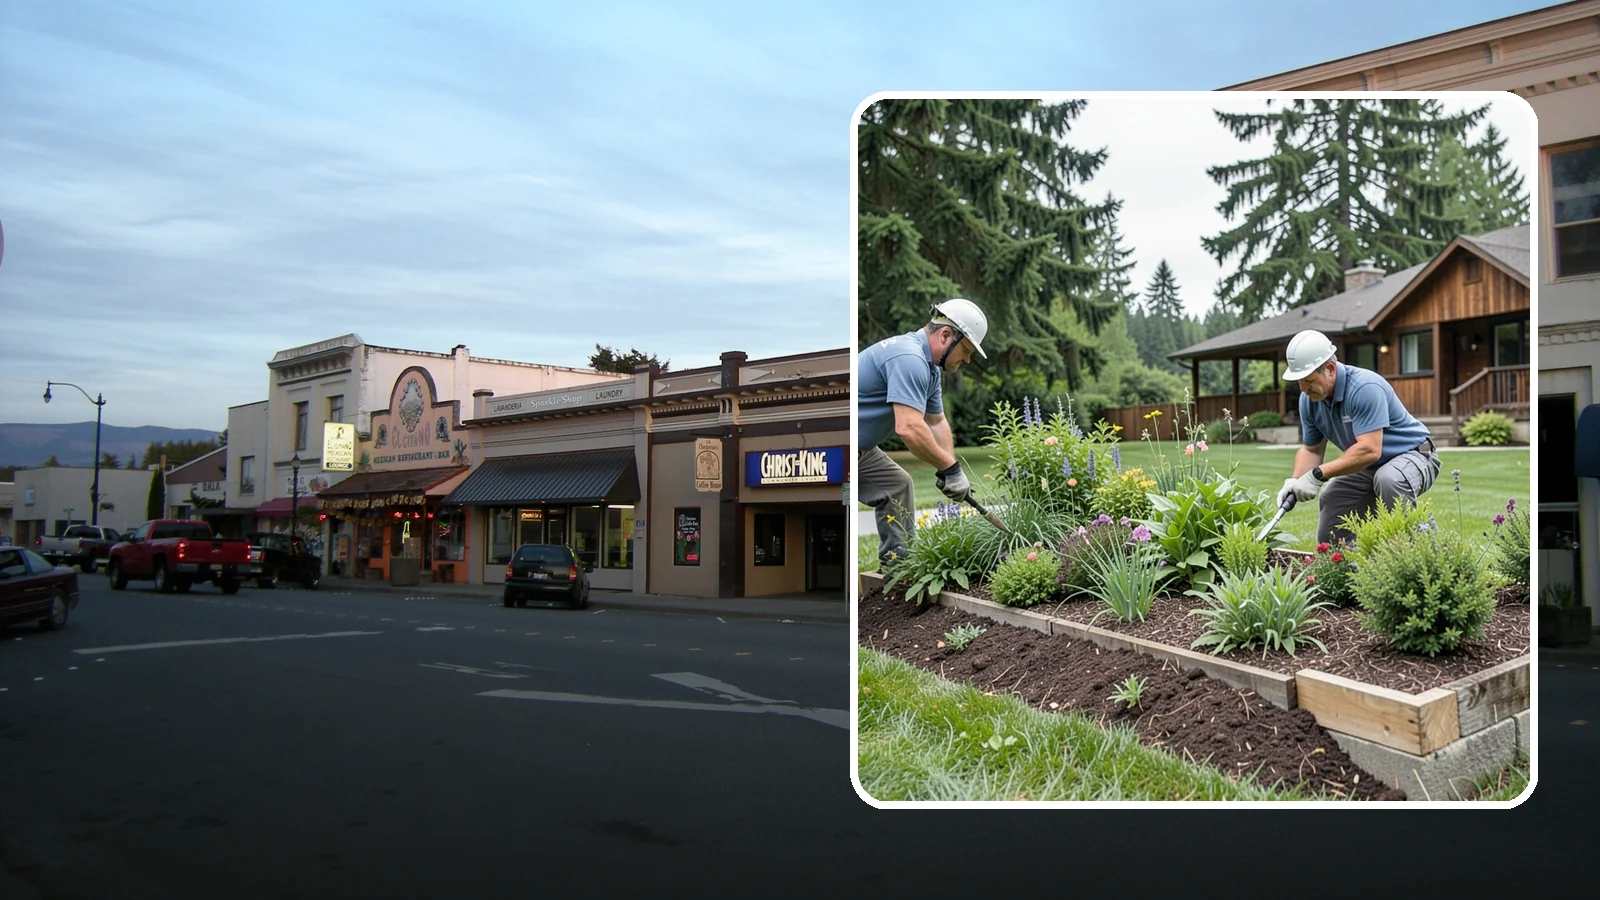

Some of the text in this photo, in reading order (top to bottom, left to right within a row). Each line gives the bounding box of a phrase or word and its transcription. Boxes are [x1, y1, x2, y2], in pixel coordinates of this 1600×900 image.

[562, 394, 582, 405] Shop
[595, 389, 623, 400] LAUNDRY
[493, 402, 522, 413] LAVANDERIA
[374, 450, 450, 464] MEXICAN RESTAURANT BAR
[761, 452, 797, 478] CHRIST
[799, 450, 827, 476] KING
